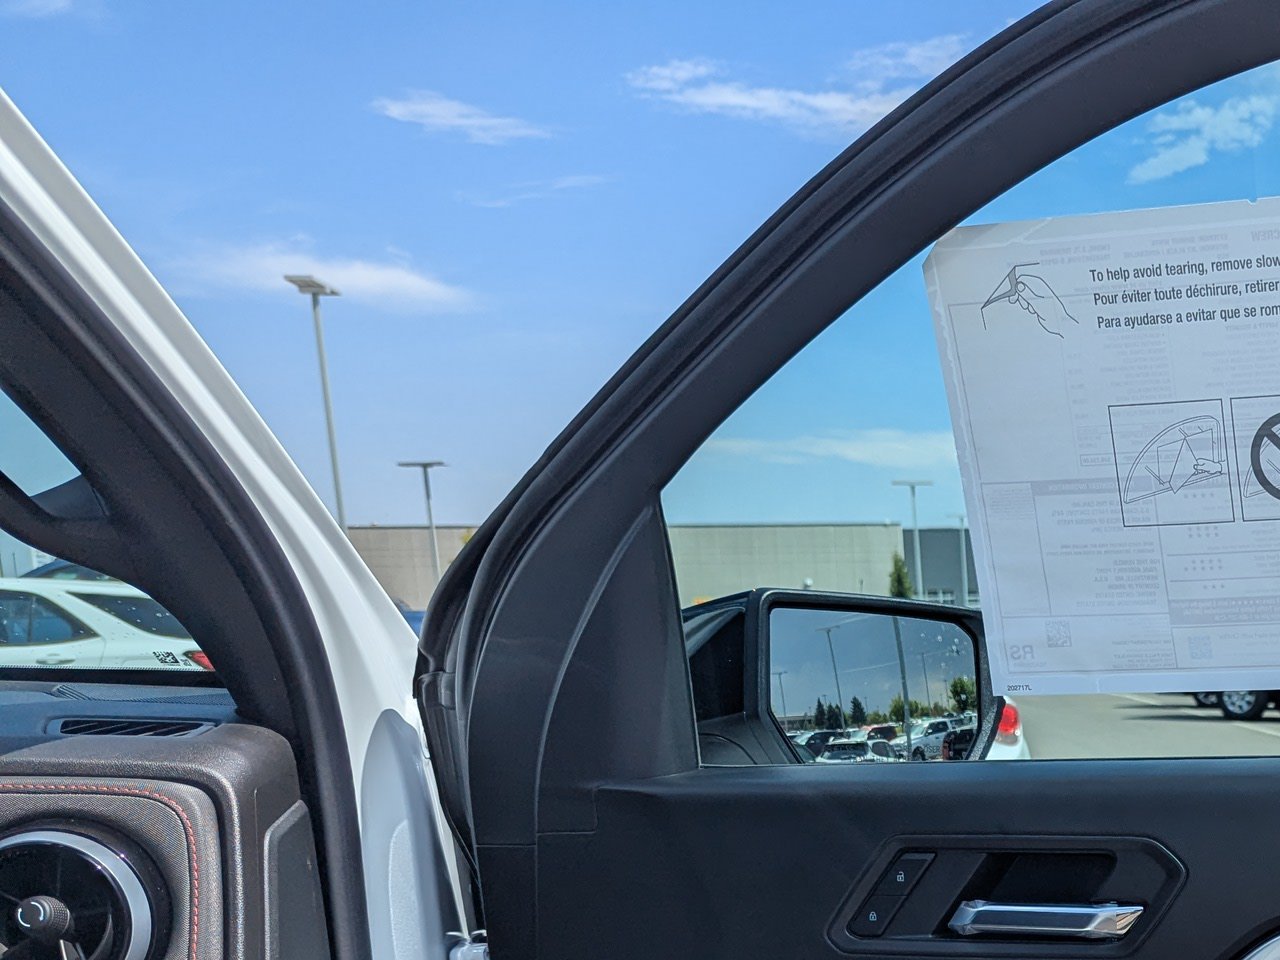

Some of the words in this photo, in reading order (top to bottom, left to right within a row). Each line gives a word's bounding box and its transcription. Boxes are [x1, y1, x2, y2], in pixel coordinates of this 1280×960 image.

[1089, 269, 1104, 282] To
[1106, 267, 1130, 282] help
[1133, 264, 1162, 279] avoid
[1165, 261, 1208, 276] tearing,
[1211, 258, 1253, 272] remove
[1093, 292, 1118, 306] Pour
[1121, 290, 1151, 304] éviter
[1154, 288, 1183, 301] toute
[1186, 284, 1242, 299] déchirure,
[1245, 278, 1280, 294] retirer
[1097, 315, 1122, 328] Para
[1124, 312, 1173, 330] ayudarse
[1176, 312, 1184, 324] a
[1186, 308, 1217, 322] evitar
[1220, 307, 1241, 322] que
[1244, 306, 1257, 318] se
[1007, 684, 1032, 692] 202717L
